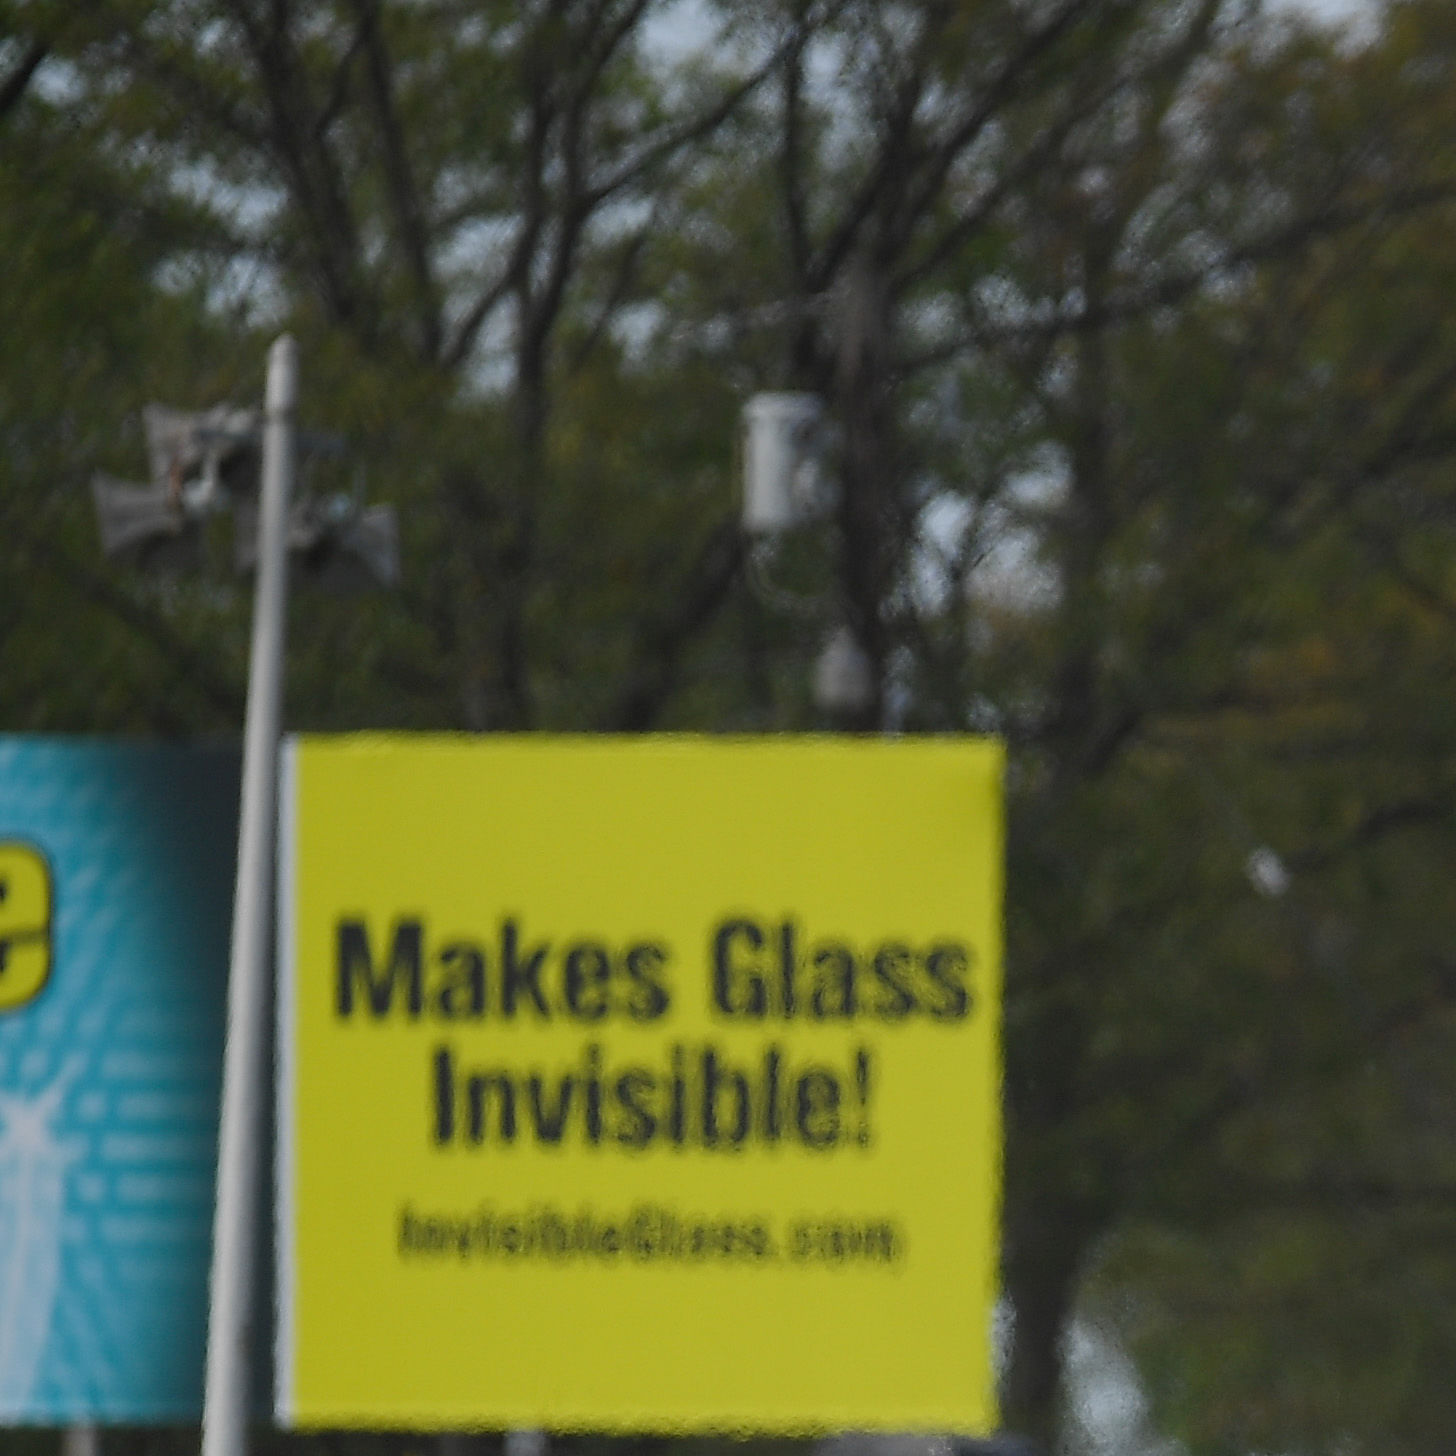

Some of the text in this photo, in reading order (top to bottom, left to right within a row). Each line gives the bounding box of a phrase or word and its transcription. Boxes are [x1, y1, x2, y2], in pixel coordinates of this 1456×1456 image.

[335, 916, 973, 1022] Makes Glass
[430, 1042, 875, 1150] Invisible!
